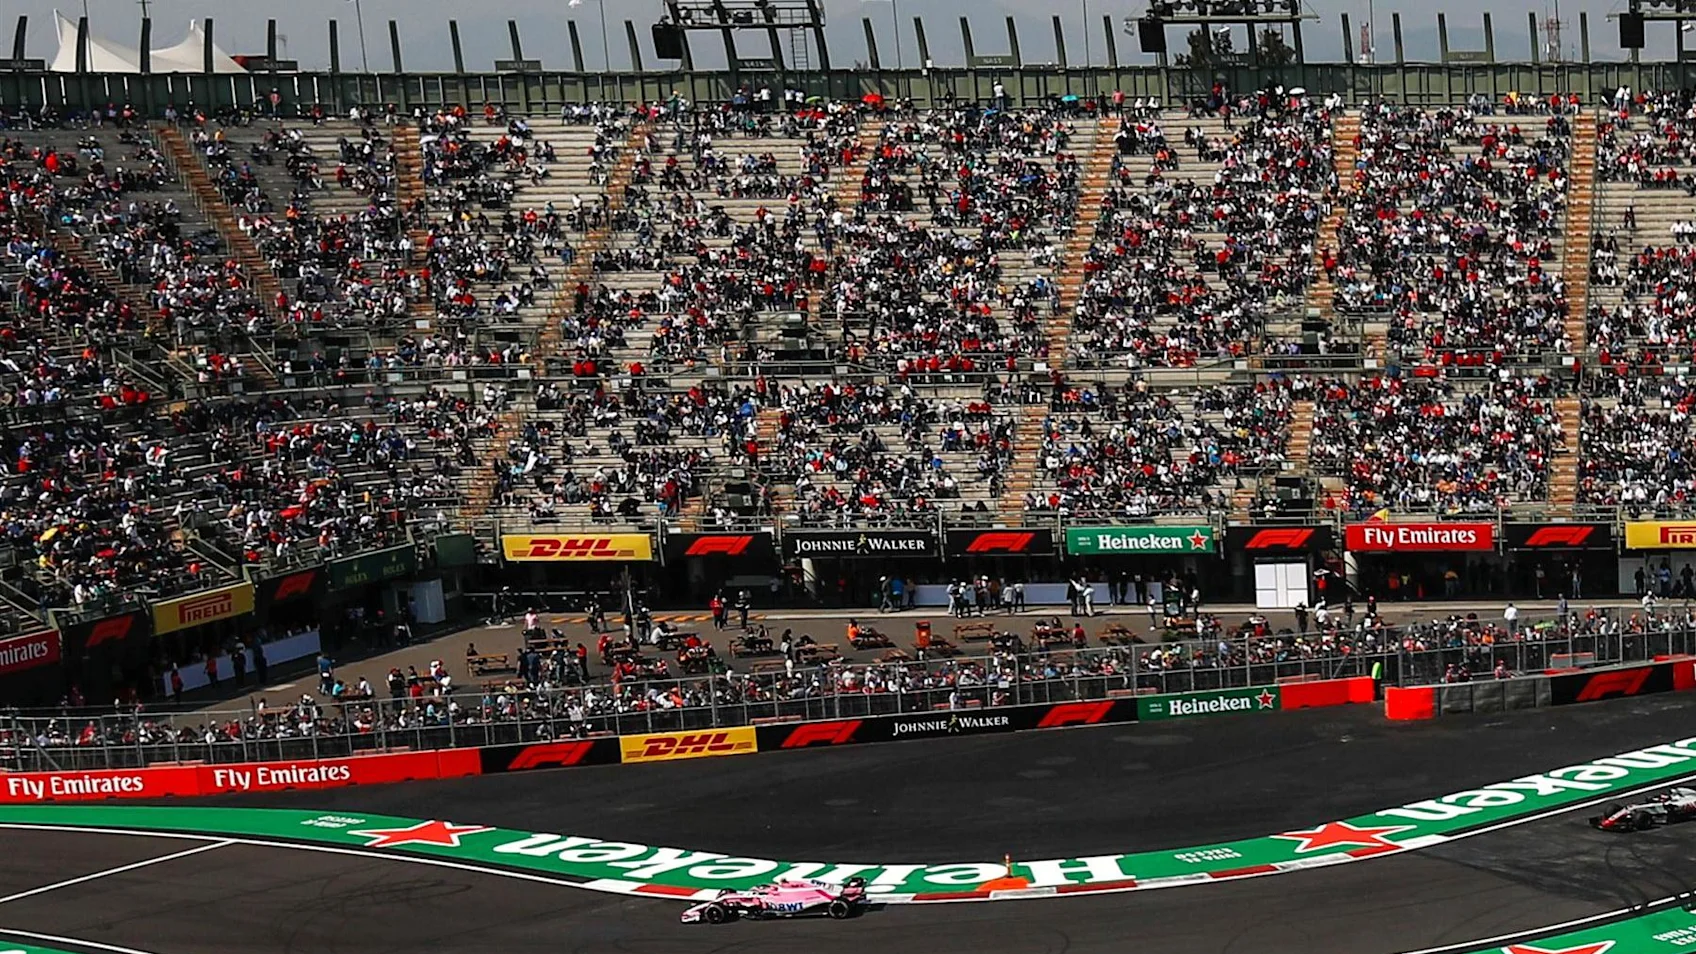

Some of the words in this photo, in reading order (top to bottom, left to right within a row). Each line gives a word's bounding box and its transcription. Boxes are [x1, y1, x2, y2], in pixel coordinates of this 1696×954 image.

[795, 538, 856, 555] JOHNNIE
[868, 537, 925, 551] WALKER
[1098, 533, 1183, 550] Heineken
[1364, 528, 1395, 547] Fly
[1398, 526, 1476, 545] Emirates
[528, 538, 619, 557] DHL
[178, 592, 232, 624] PIRELLI
[1168, 696, 1251, 716] Heineken
[892, 721, 948, 736] JOHNNIE
[958, 715, 1009, 728] WALKER
[643, 733, 736, 757] DHL
[7, 777, 44, 799] Fly
[50, 775, 144, 796] Emirates
[213, 769, 251, 790] Fly
[257, 763, 350, 786] Emirates
